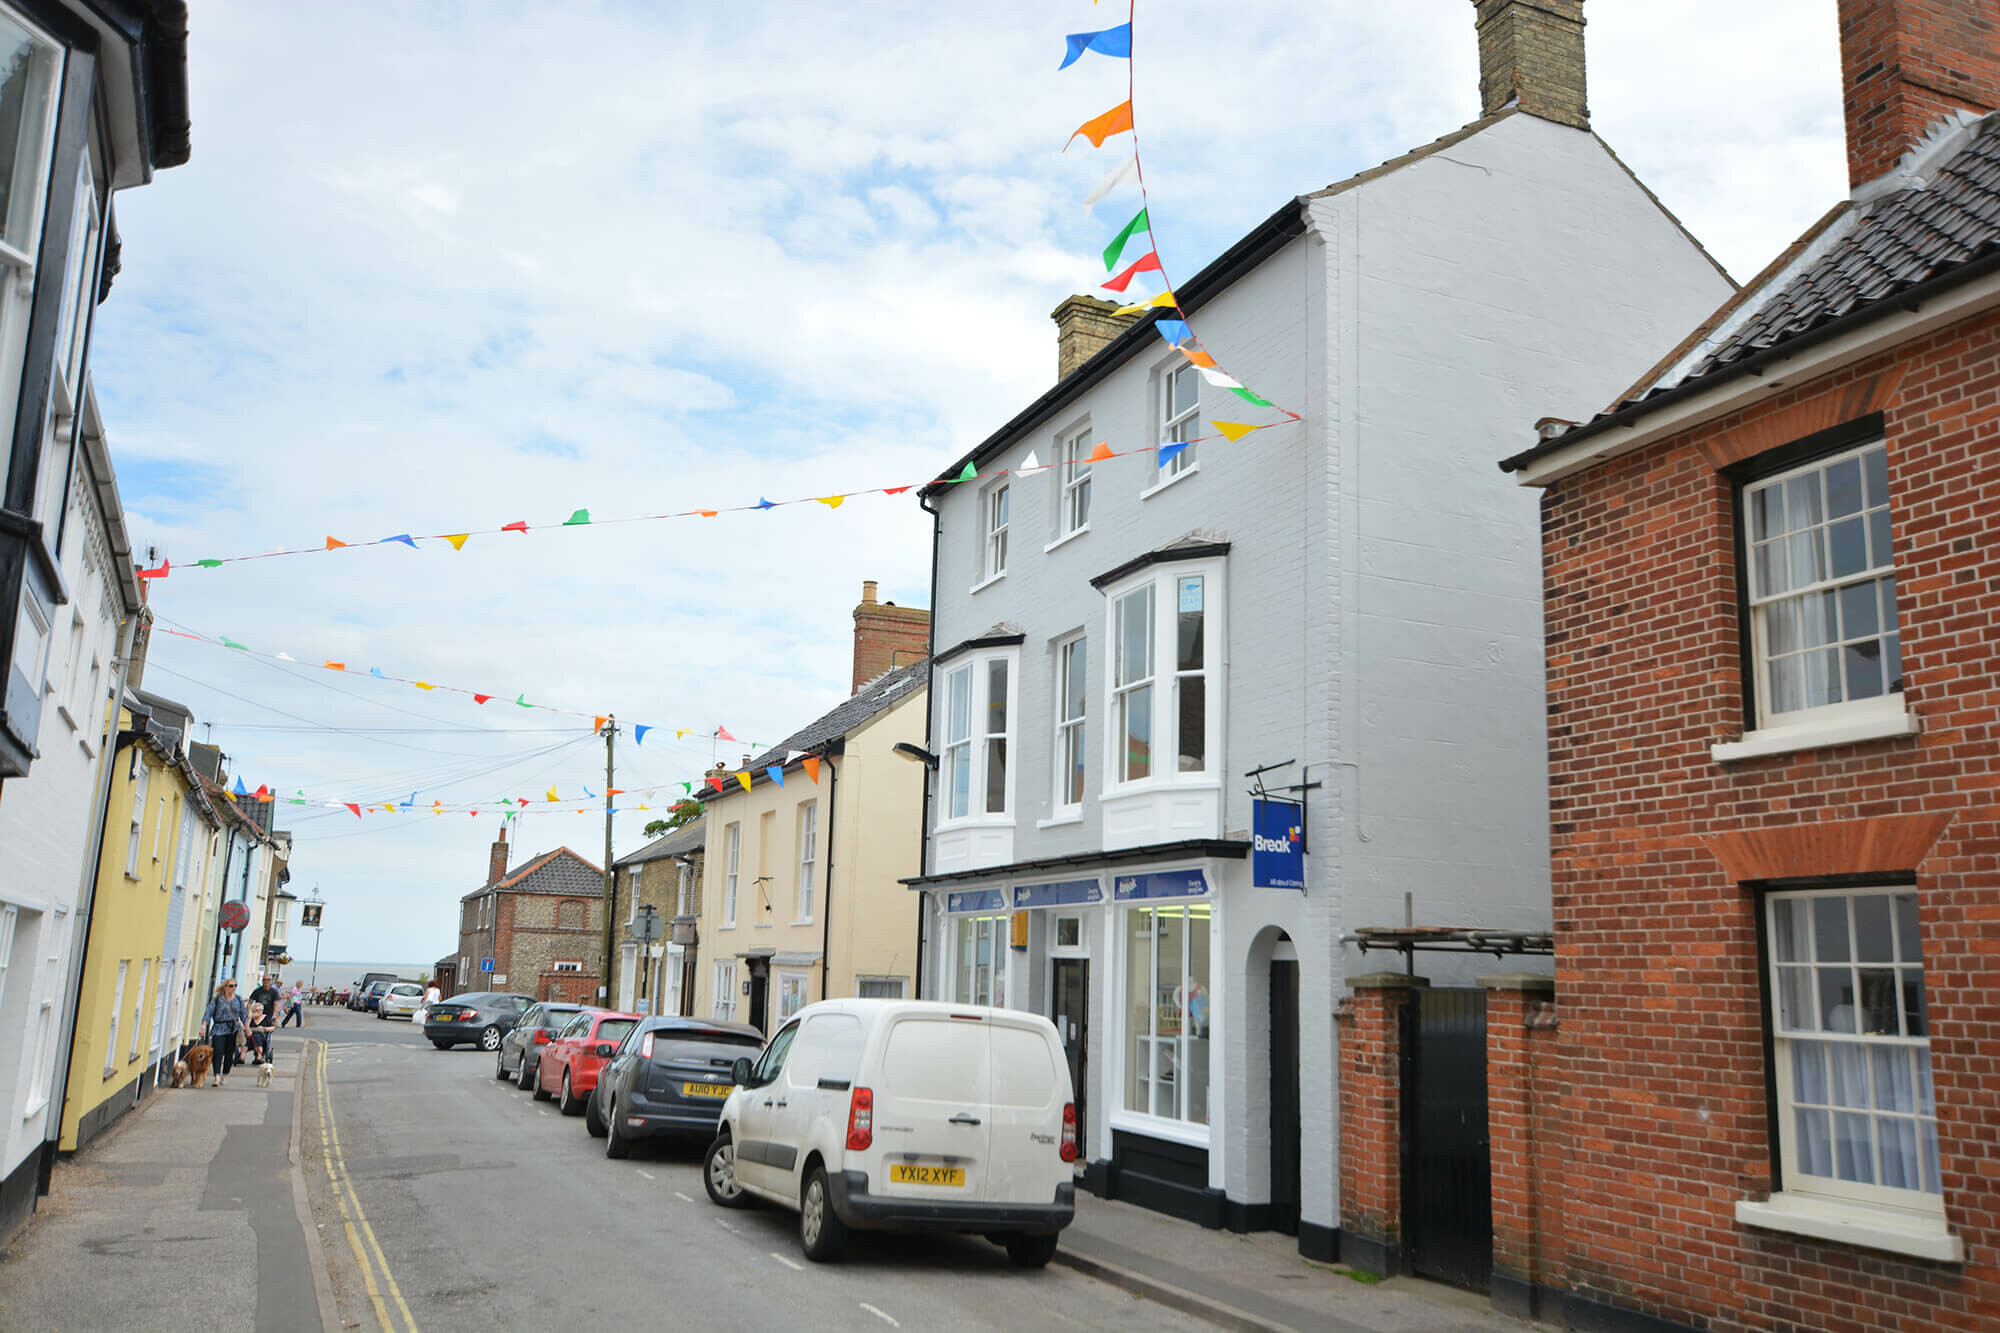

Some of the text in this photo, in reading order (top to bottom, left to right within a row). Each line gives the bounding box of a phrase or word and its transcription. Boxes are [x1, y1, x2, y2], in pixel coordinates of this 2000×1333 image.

[1254, 834, 1291, 854] Break
[689, 1084, 710, 1095] AU10
[900, 1165, 958, 1183] YX12 XYF
